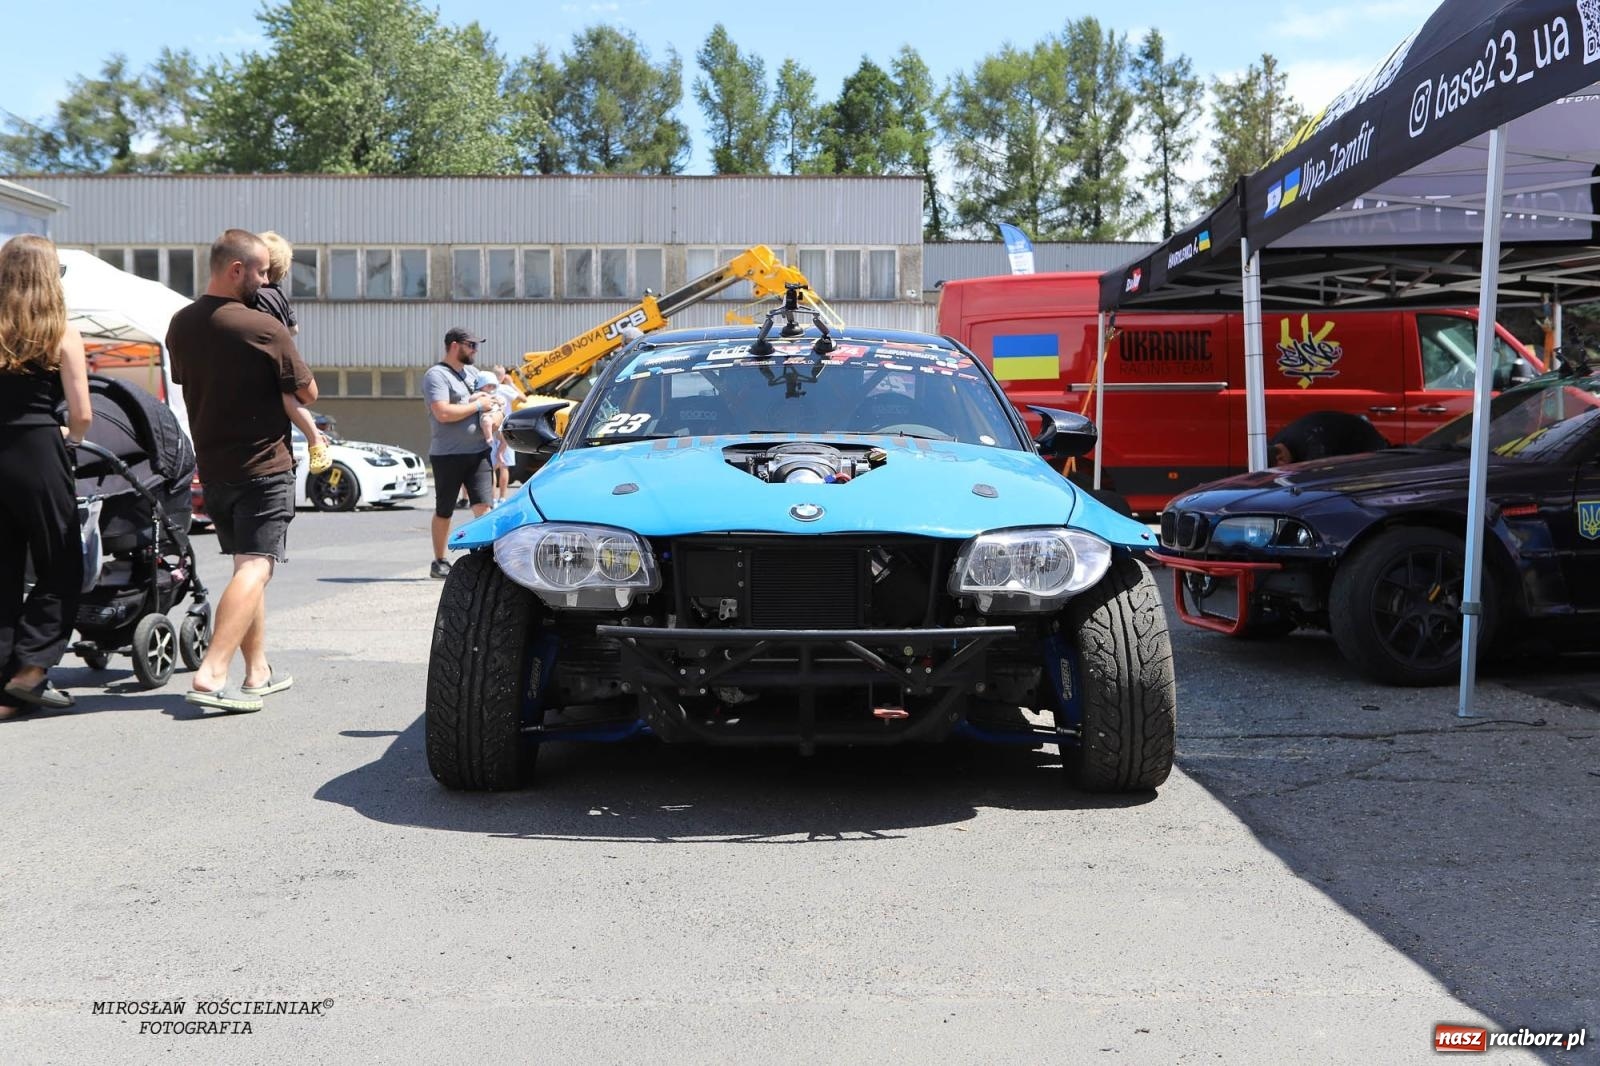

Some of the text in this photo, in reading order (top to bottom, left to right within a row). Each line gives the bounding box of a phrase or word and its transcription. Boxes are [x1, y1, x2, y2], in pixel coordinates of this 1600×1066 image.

[1434, 16, 1570, 120] base23_ua
[1325, 120, 1375, 181] Zamfir
[605, 308, 648, 341] JCB
[1120, 330, 1213, 361] UKRAINE
[1120, 362, 1215, 376] RACING TEAM
[600, 413, 652, 434] 23
